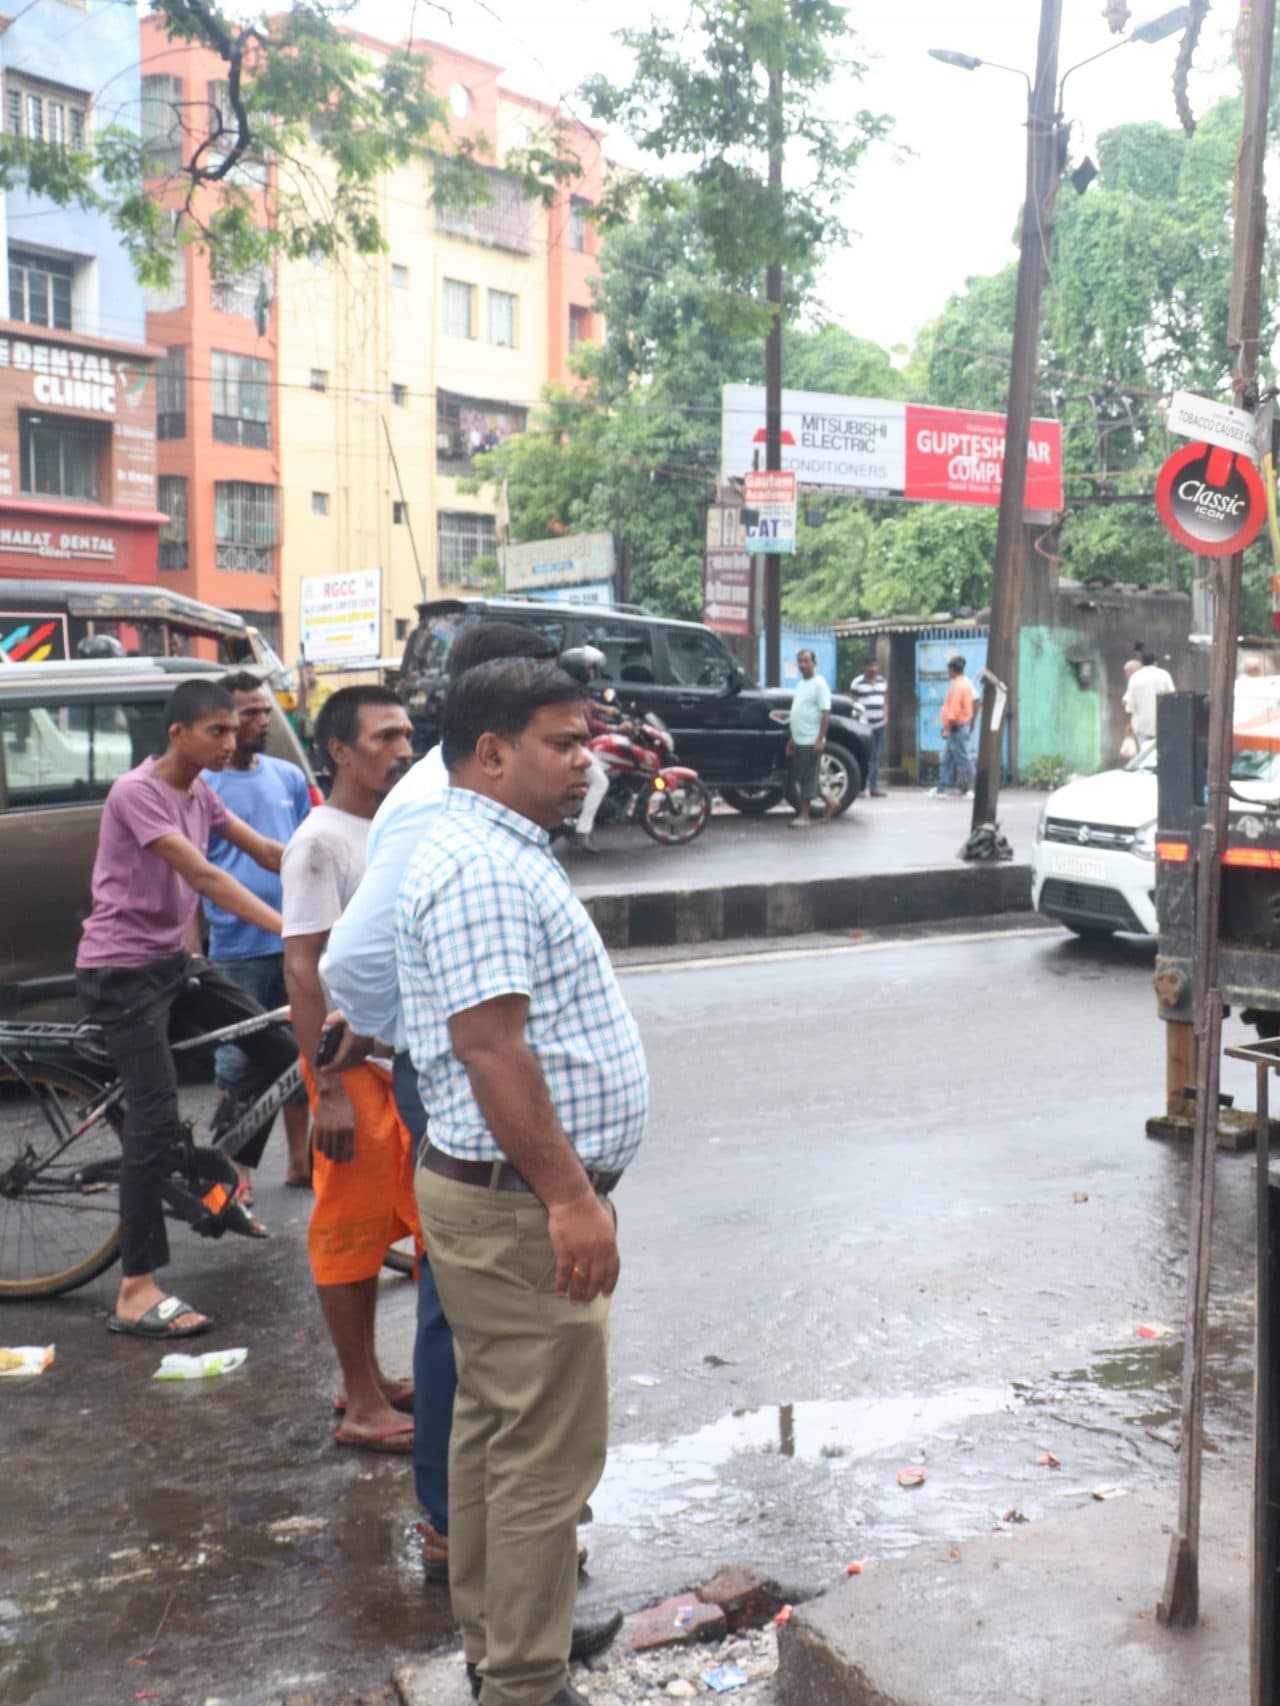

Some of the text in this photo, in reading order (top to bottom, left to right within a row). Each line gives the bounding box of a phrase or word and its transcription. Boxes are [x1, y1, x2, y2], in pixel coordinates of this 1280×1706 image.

[13, 341, 116, 388] DENTAL
[32, 374, 117, 414] CLINIC
[801, 414, 888, 438] MITSUBISHI
[1180, 409, 1215, 432] TOBACCO
[1215, 421, 1245, 440] CAUSES
[801, 433, 876, 453] ELECTRIC
[916, 429, 1050, 464] GUPTESHAR
[948, 457, 1004, 484] COMPL
[1178, 480, 1246, 516] Classic
[60, 533, 114, 553] DENTAL
[323, 579, 356, 599] RGCC
